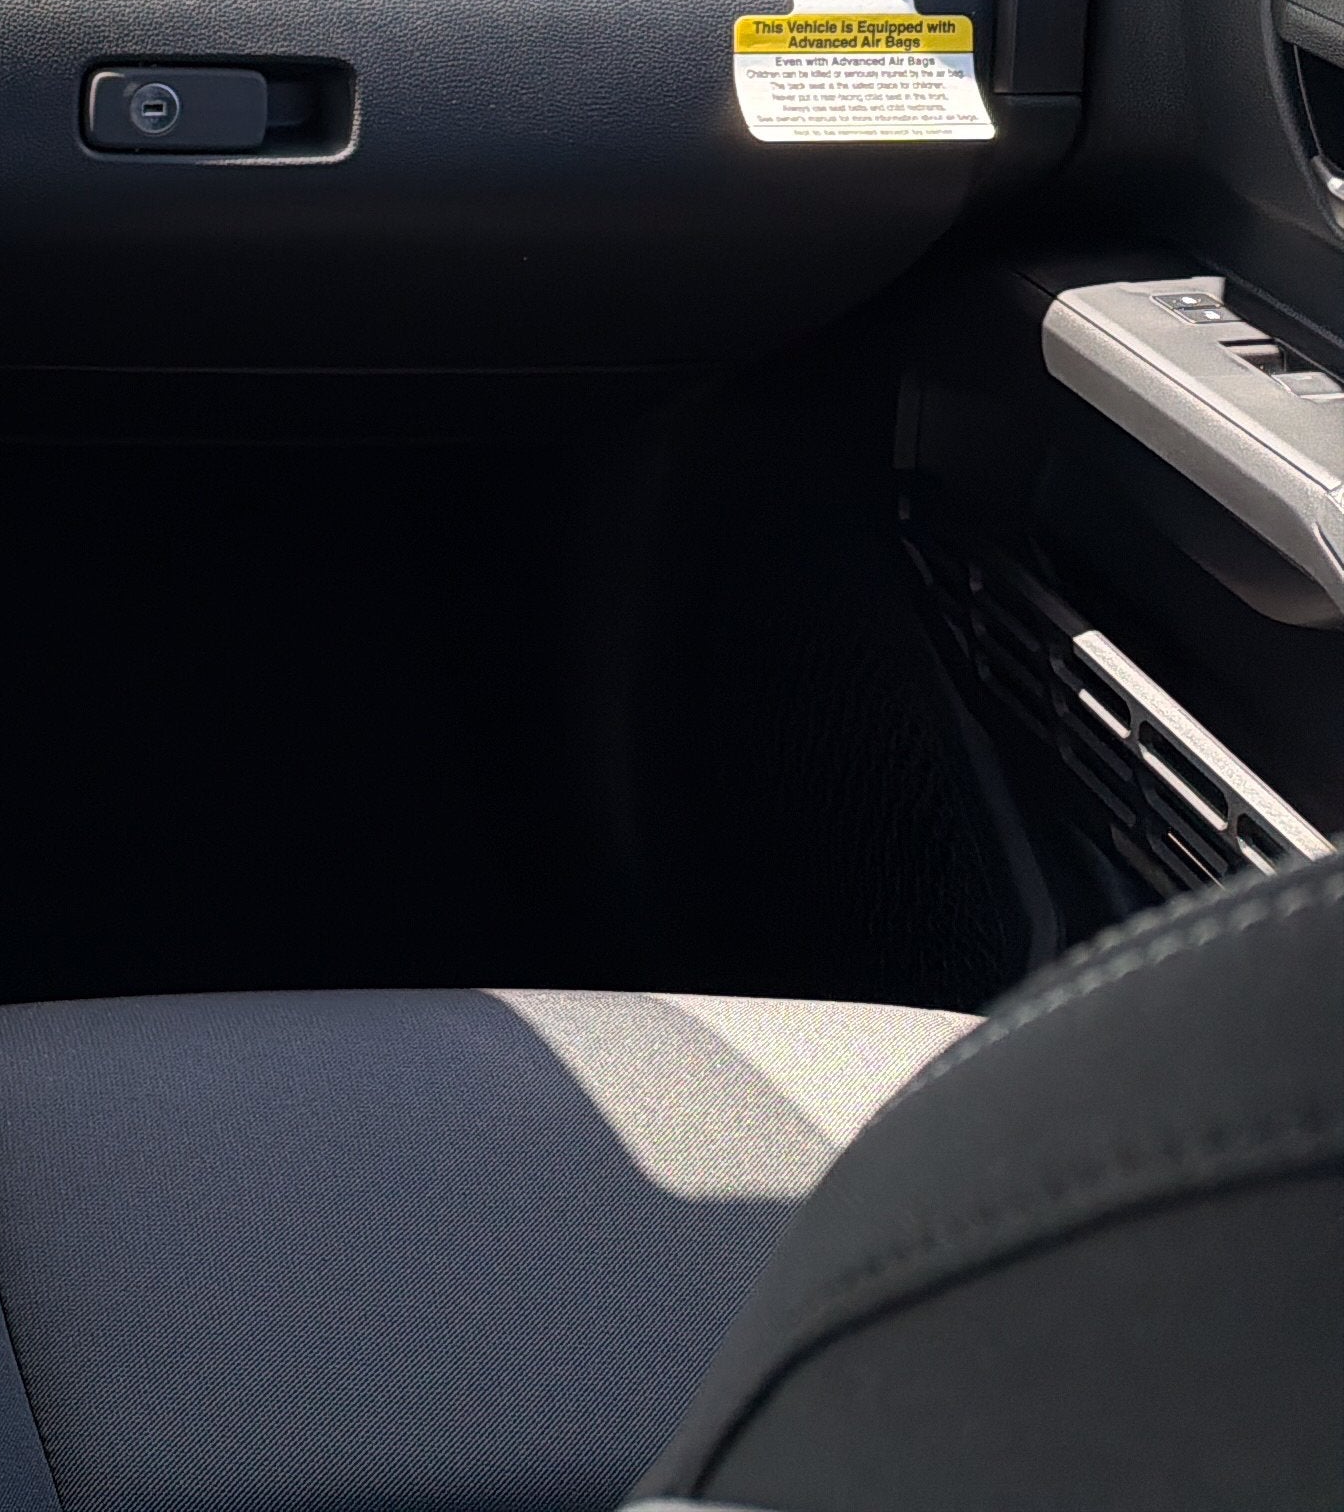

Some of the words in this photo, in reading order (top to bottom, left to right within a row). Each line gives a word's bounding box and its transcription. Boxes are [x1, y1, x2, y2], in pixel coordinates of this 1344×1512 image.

[753, 20, 784, 34] This
[788, 20, 837, 34] Vehicle
[857, 20, 923, 37] Equipped
[927, 20, 956, 34] with
[788, 36, 858, 49] Advanced
[861, 36, 882, 49] Air
[885, 36, 921, 51] Bags
[775, 57, 803, 66] Even
[805, 57, 828, 66] with
[831, 56, 885, 67] Advanced
[888, 56, 904, 66] Air
[907, 56, 935, 68] Bags
